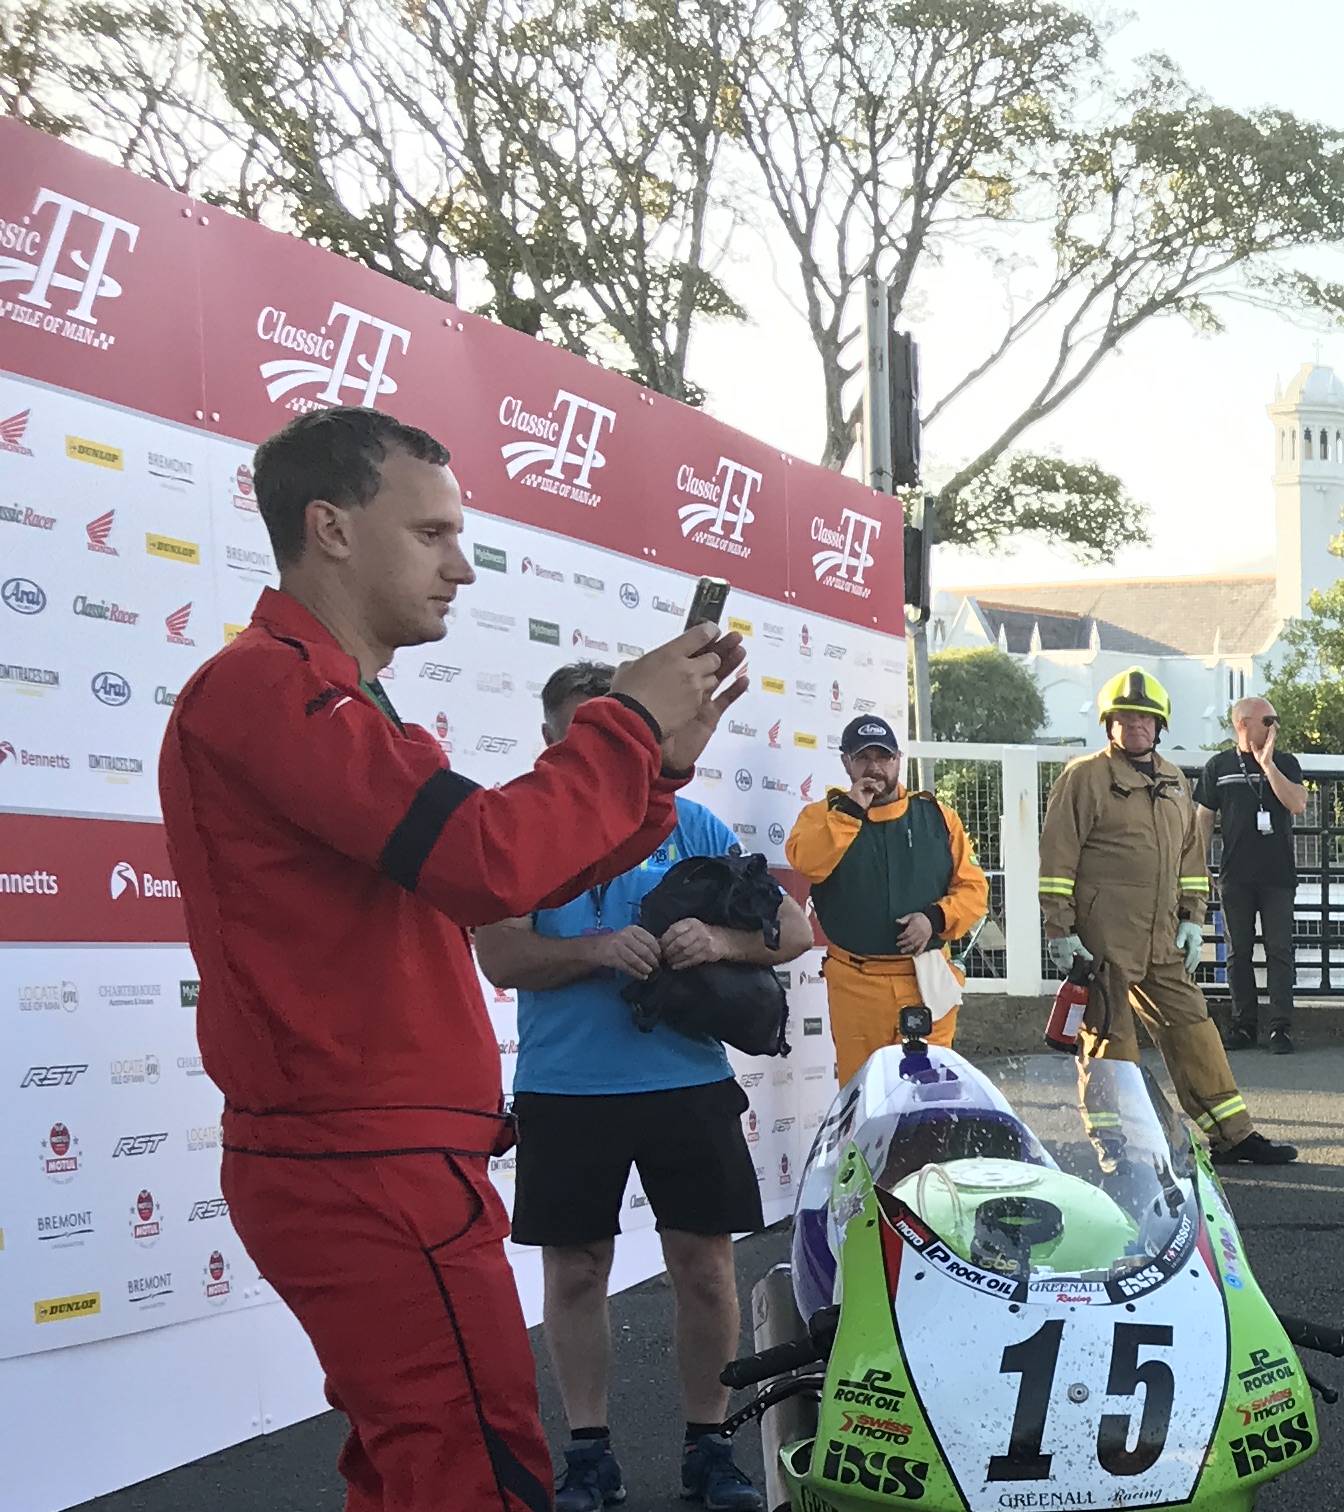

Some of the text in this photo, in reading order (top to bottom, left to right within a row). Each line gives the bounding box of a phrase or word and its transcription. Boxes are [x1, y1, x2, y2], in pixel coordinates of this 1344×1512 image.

[18, 186, 140, 325] TT
[11, 304, 95, 344] ISLE OF MAN
[257, 306, 336, 361] Classic
[316, 301, 411, 408] TT
[499, 395, 559, 442] Classic
[545, 389, 617, 489] TT
[77, 444, 118, 463] DUNLOP
[148, 451, 193, 475] BREMONT
[542, 477, 559, 495] ISLE
[569, 486, 590, 505] MAN
[676, 463, 721, 504] Classic
[710, 456, 763, 543] TT
[24, 506, 57, 532] Racer
[810, 512, 844, 551] Classic
[156, 541, 196, 557] DUNLOP
[225, 545, 271, 567] BREMONT
[838, 507, 882, 585] TT
[72, 594, 139, 625] Classic Racer
[0, 663, 60, 686] OMTTRACES.COM
[419, 662, 461, 683] RST
[154, 685, 177, 706] Clas
[476, 735, 518, 754] RST
[20, 749, 71, 770] Bennetts
[0, 870, 58, 896] nnetts
[18, 985, 59, 1002] LOCATE
[99, 984, 162, 998] CHARTERHOUSE
[20, 1064, 89, 1088] RST
[110, 1059, 144, 1076] LOCATE
[112, 1132, 168, 1158] RST
[186, 1127, 217, 1143] LOCATE
[47, 1158, 78, 1172] MOTUL
[37, 1211, 92, 1231] BREMONT
[135, 1222, 160, 1238] MOTUL
[1170, 1212, 1193, 1254] TISSOT
[128, 1272, 172, 1294] BREMONT
[946, 1260, 984, 1288] ROCK
[985, 1277, 1012, 1297] OIL
[1028, 1281, 1105, 1294] GREENALL
[49, 1298, 97, 1316] DUNLOP
[1055, 1294, 1093, 1304] Racing
[1243, 1365, 1295, 1393] ROCK OIL
[832, 1387, 900, 1412] ROCK OIL
[986, 1319, 1176, 1482] 15
[999, 1488, 1164, 1509] GREENALL Racing
